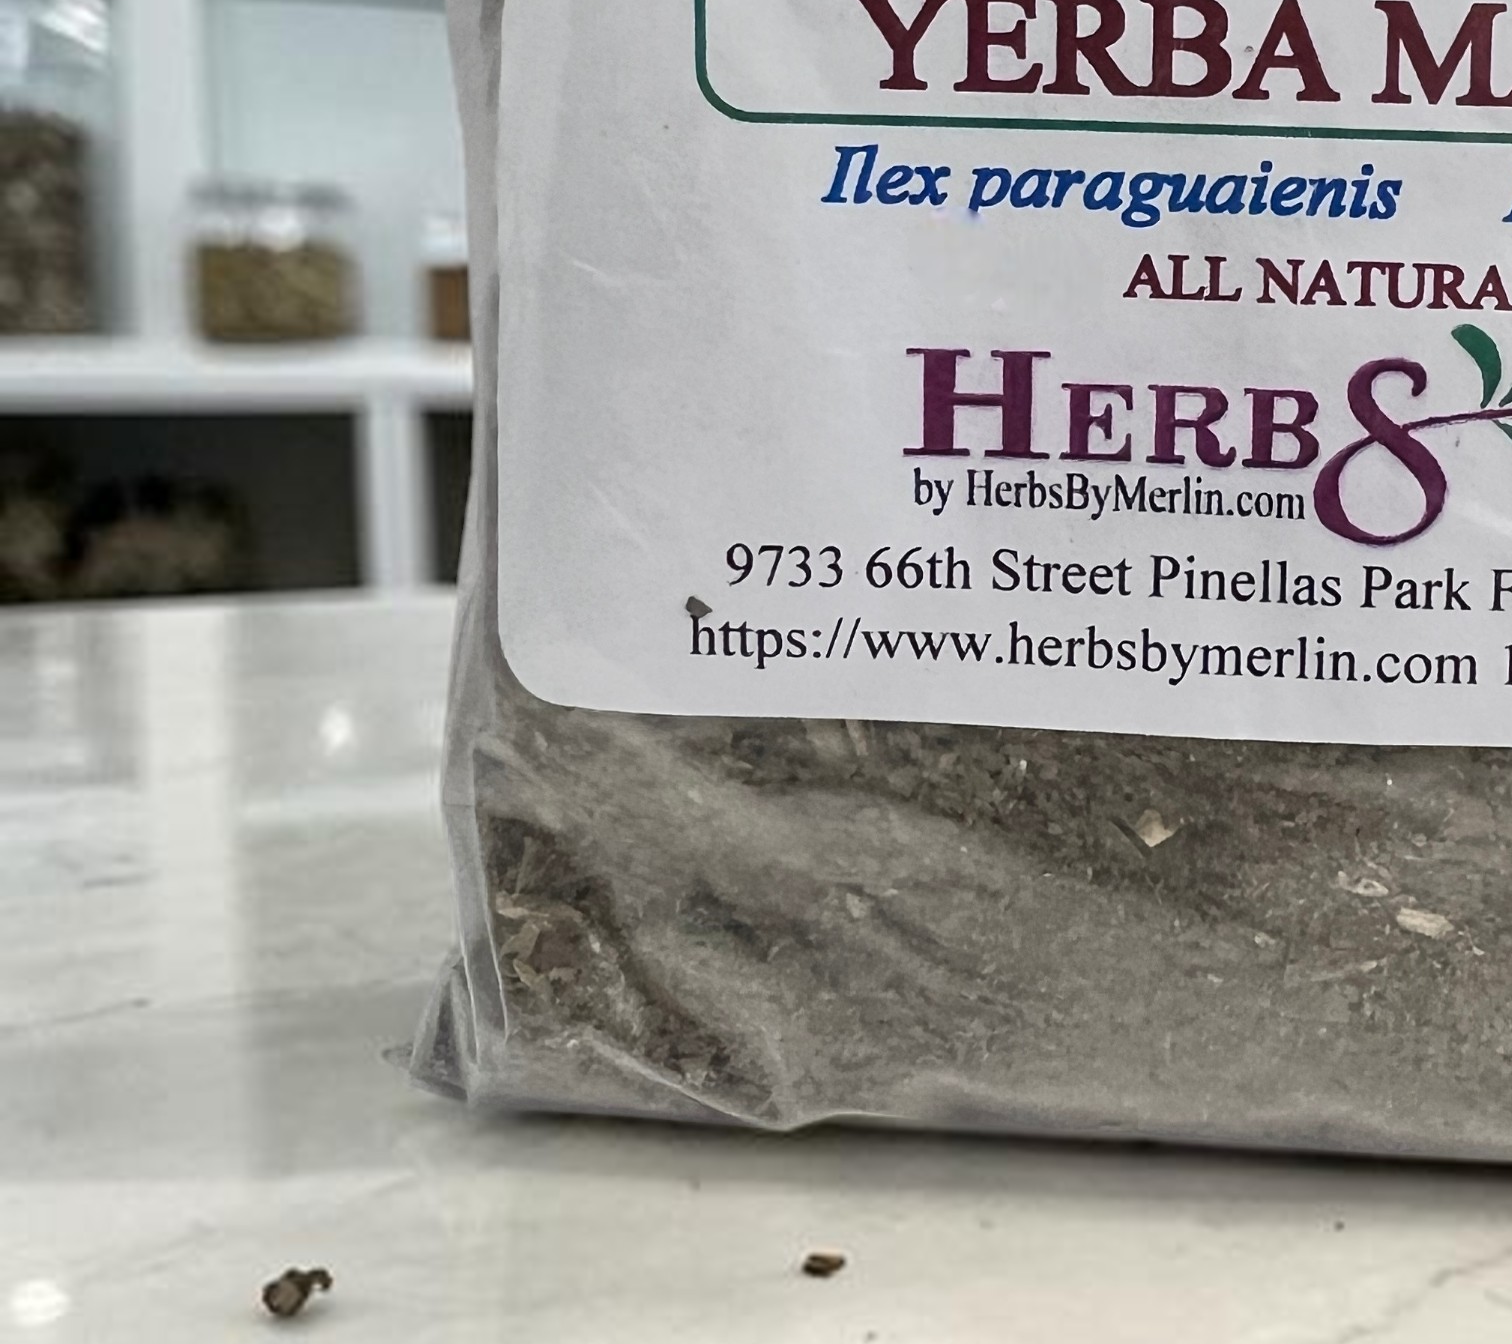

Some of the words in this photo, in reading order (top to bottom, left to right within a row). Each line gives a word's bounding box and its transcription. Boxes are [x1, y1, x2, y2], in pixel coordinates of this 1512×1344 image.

[821, 144, 951, 205] Ilex
[969, 159, 1402, 228] paraguaienis
[1122, 254, 1243, 302] ALL
[913, 467, 955, 515] by
[966, 469, 1306, 520] HerbsByMerlin.com
[726, 543, 844, 588] 9733
[865, 546, 972, 590] 66th
[992, 548, 1132, 596] Street
[1148, 554, 1342, 609] Pinellas
[1360, 565, 1472, 611] Park
[690, 615, 1478, 686] https://www.herbsbymerlin.com
